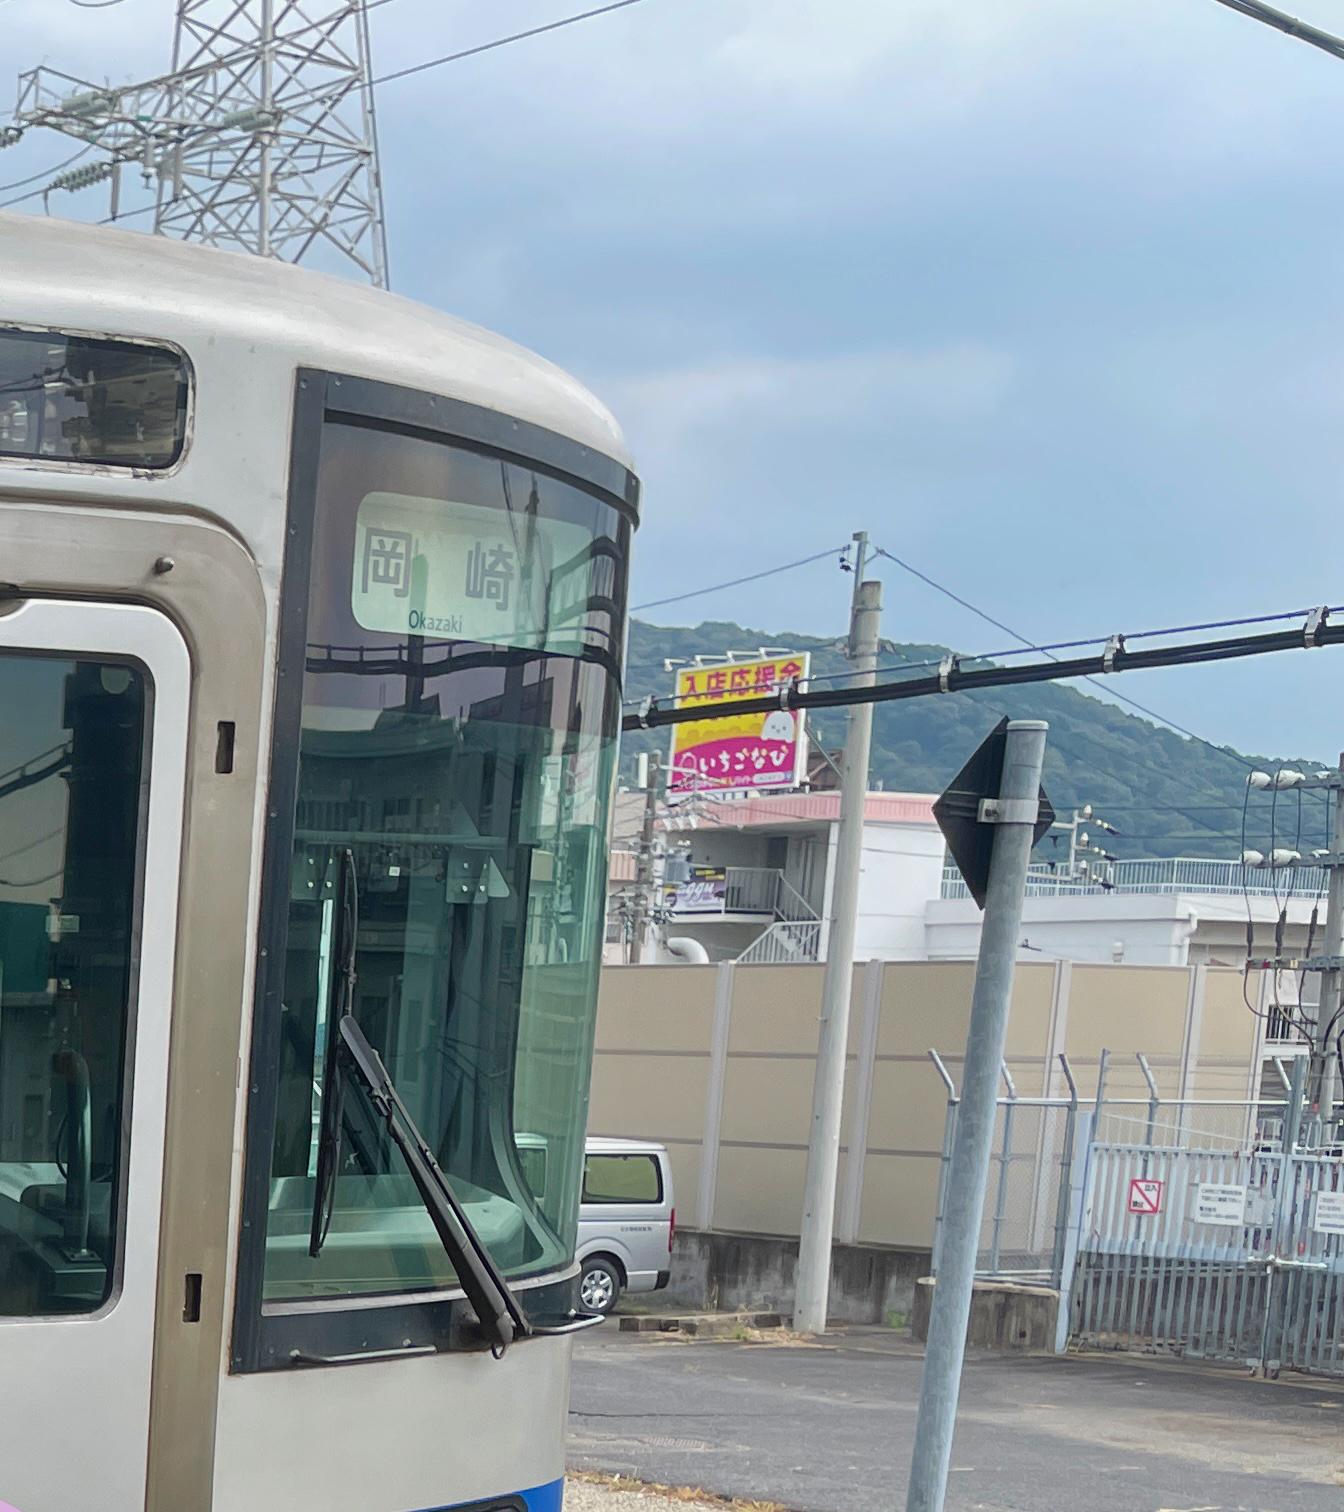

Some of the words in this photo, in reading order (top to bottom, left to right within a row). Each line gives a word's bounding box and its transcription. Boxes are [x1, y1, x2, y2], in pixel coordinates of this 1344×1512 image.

[360, 527, 516, 612] 岡崎
[408, 609, 463, 634] Okazaki
[698, 744, 790, 773] いちごなび
